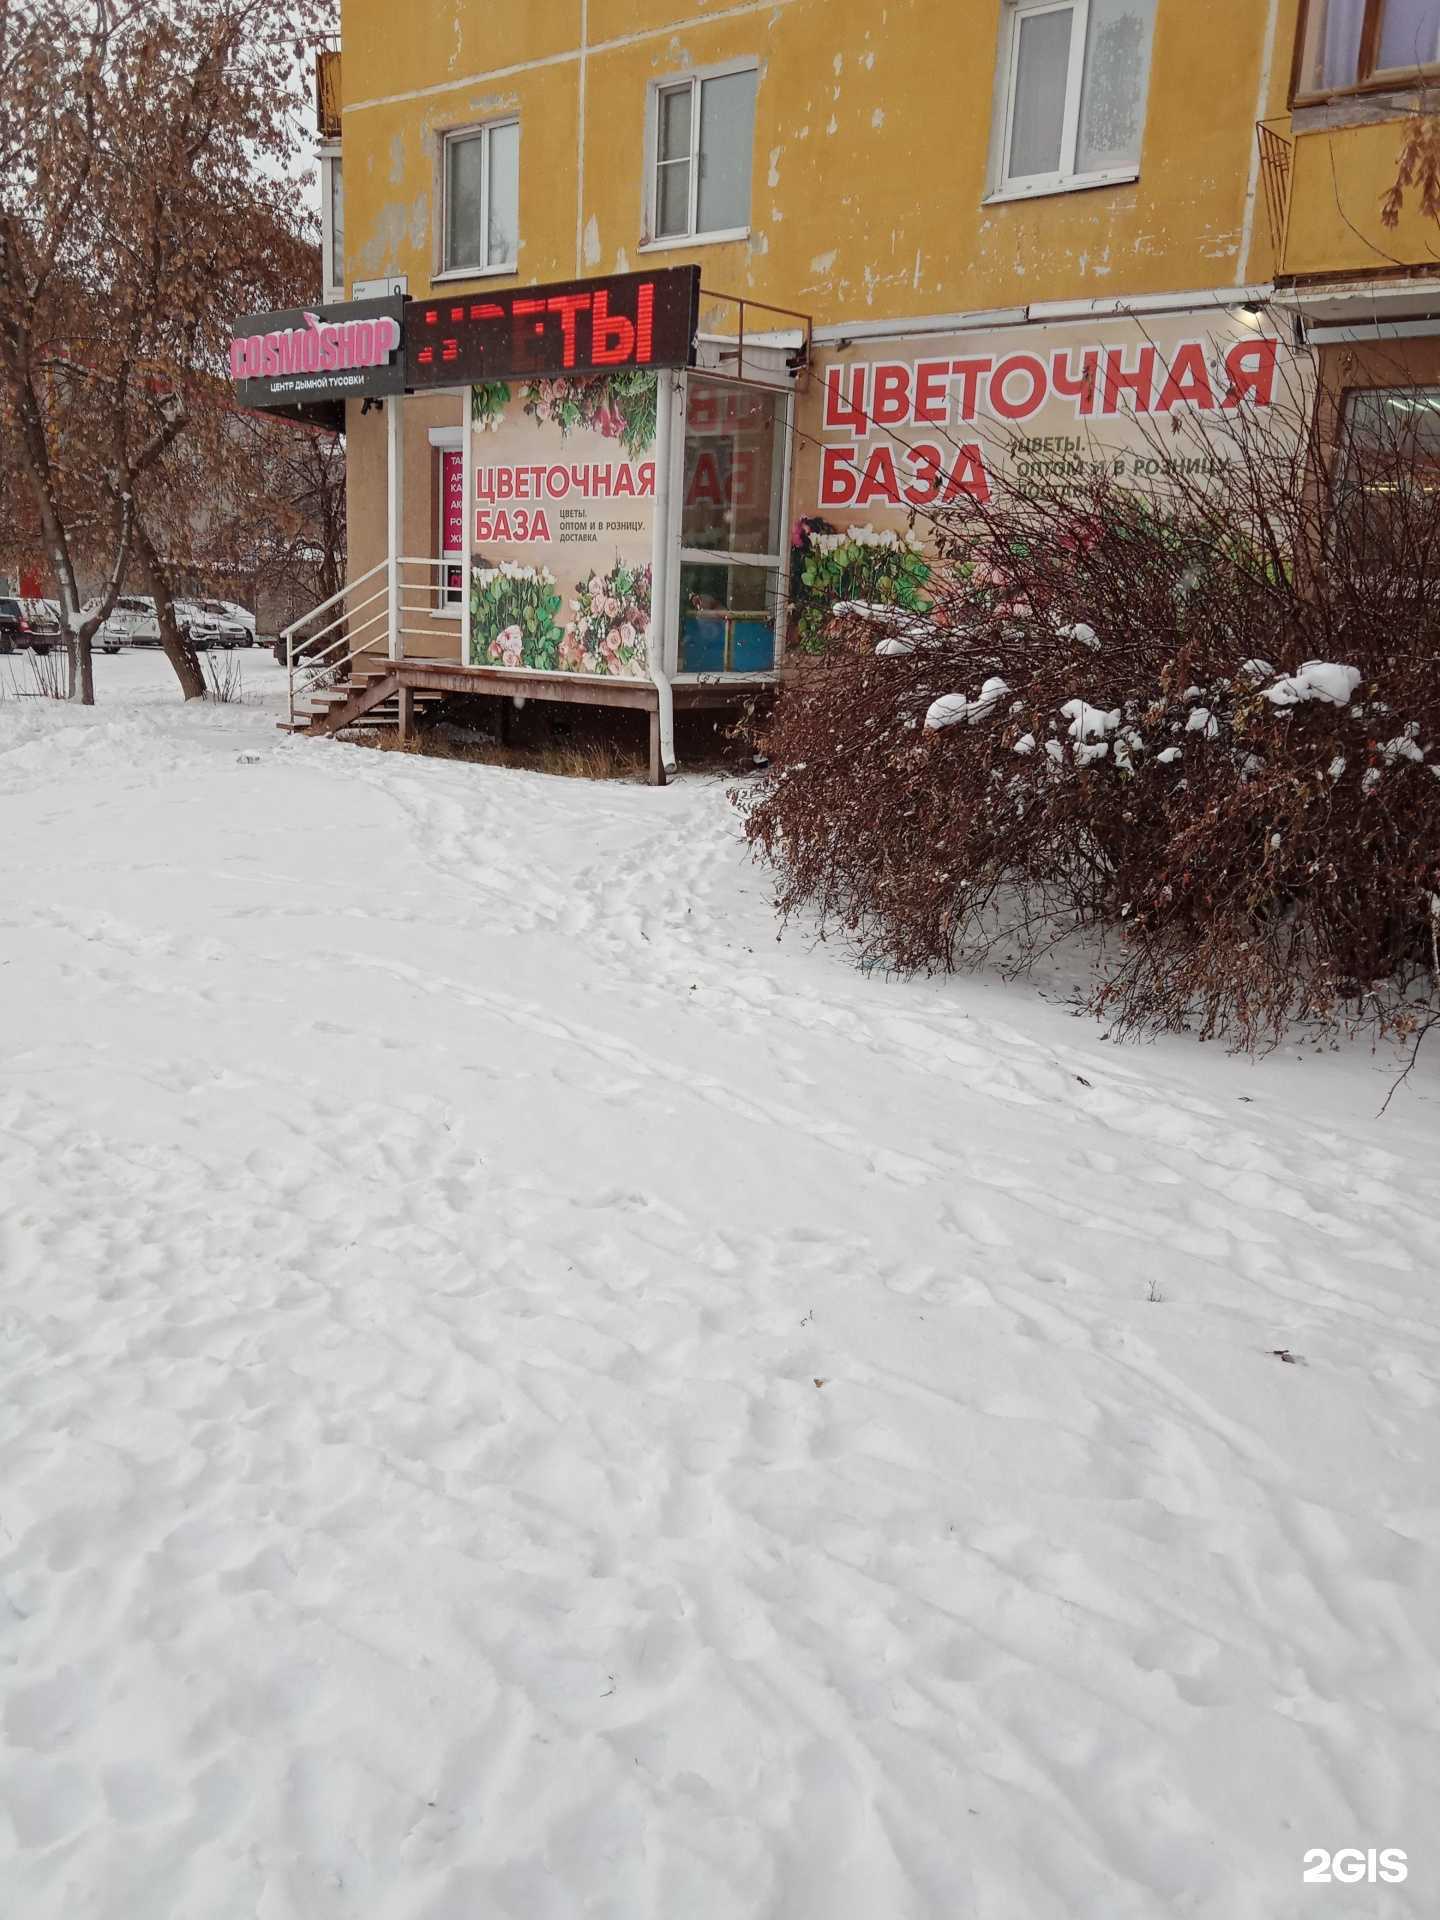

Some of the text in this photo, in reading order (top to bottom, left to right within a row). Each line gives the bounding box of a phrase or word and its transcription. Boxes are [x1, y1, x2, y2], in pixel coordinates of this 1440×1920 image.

[231, 317, 399, 380] COSMOSHOP
[270, 375, 365, 393] ЦЕНТР ДЫМНОЙ ТУСОВКИ
[825, 337, 1278, 436] ЦВЕТОЧНАЯ
[475, 462, 656, 505] ЦВЕТОЧНАЯ
[820, 443, 993, 506] БАЗА
[1113, 458, 1126, 476] В
[475, 509, 551, 542] БАЗА
[560, 521, 587, 531] ОПТОМ
[589, 521, 596, 531] И
[598, 521, 604, 531] В
[560, 533, 598, 543] ДОСТАВКА
